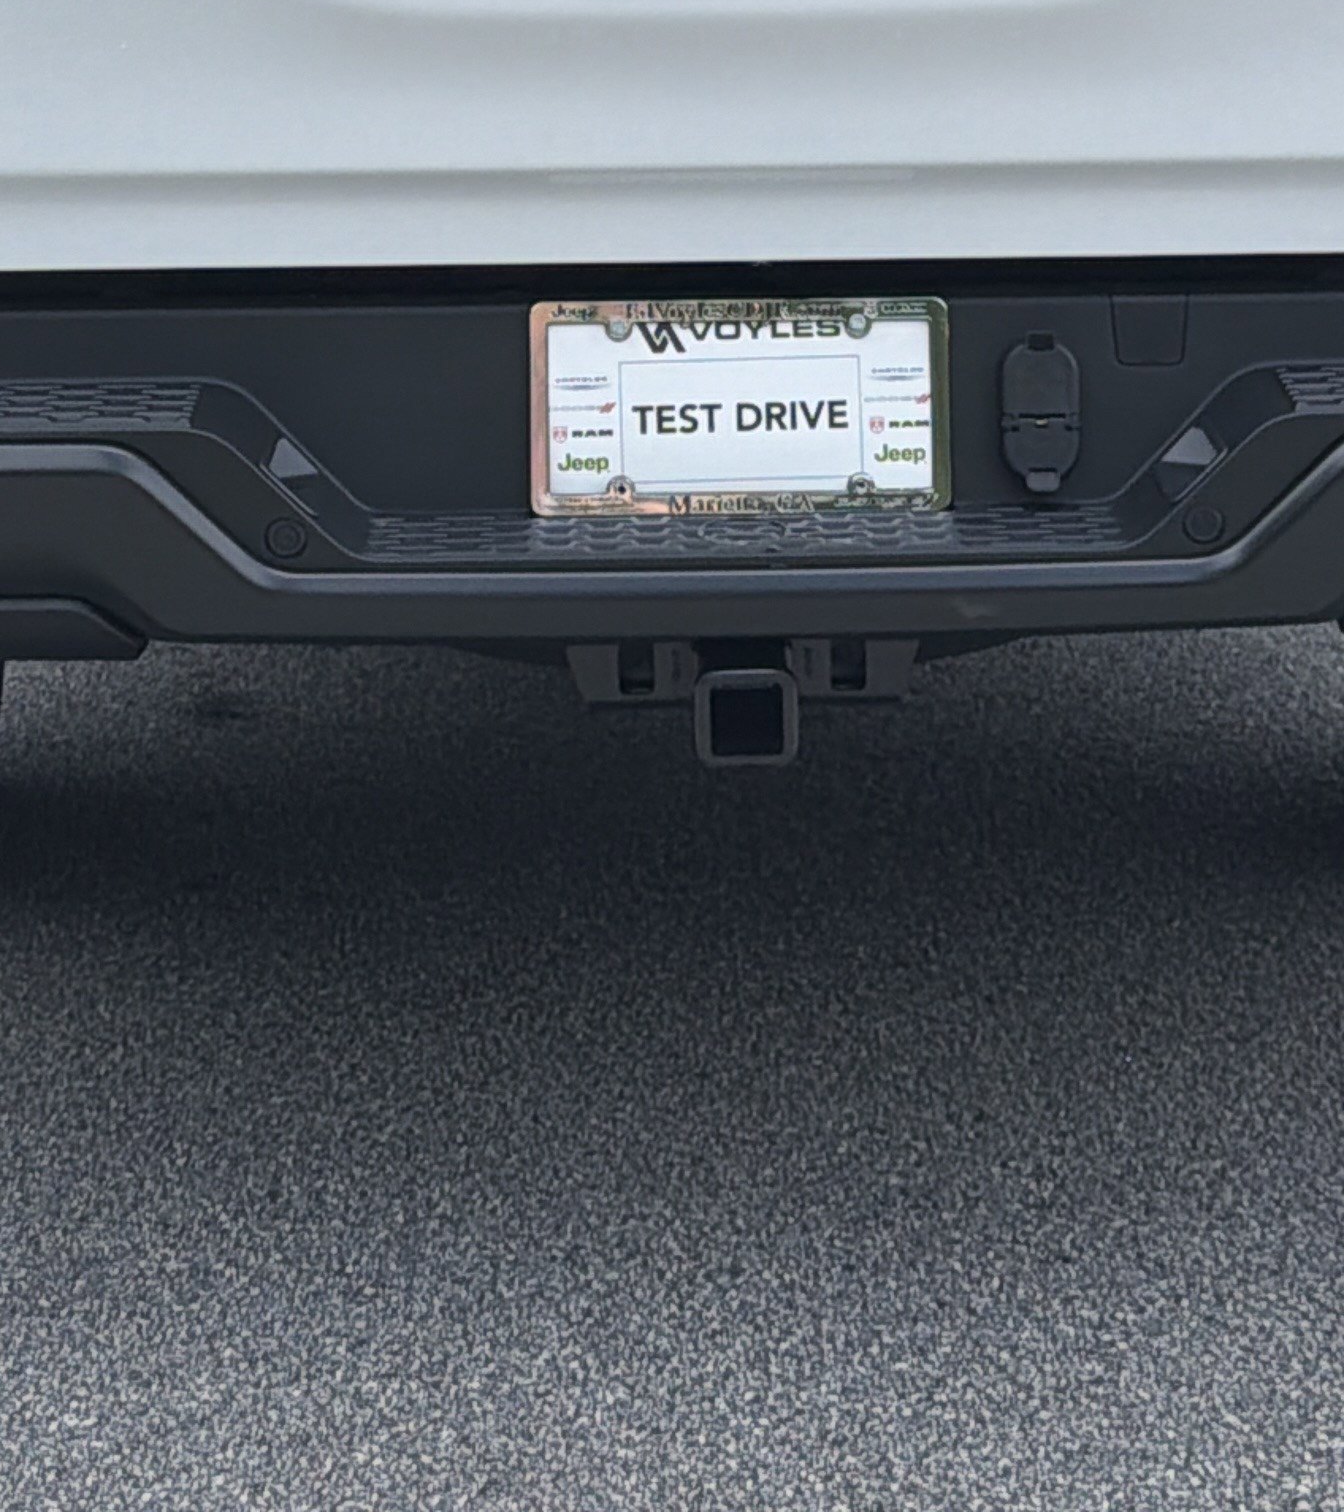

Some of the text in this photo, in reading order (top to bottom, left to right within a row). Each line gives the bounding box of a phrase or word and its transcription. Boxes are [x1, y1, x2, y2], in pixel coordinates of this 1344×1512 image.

[689, 321, 841, 341] VOYLES
[631, 399, 849, 434] TEST DRIVE
[557, 452, 610, 474] Jeep
[874, 443, 927, 464] Jeep
